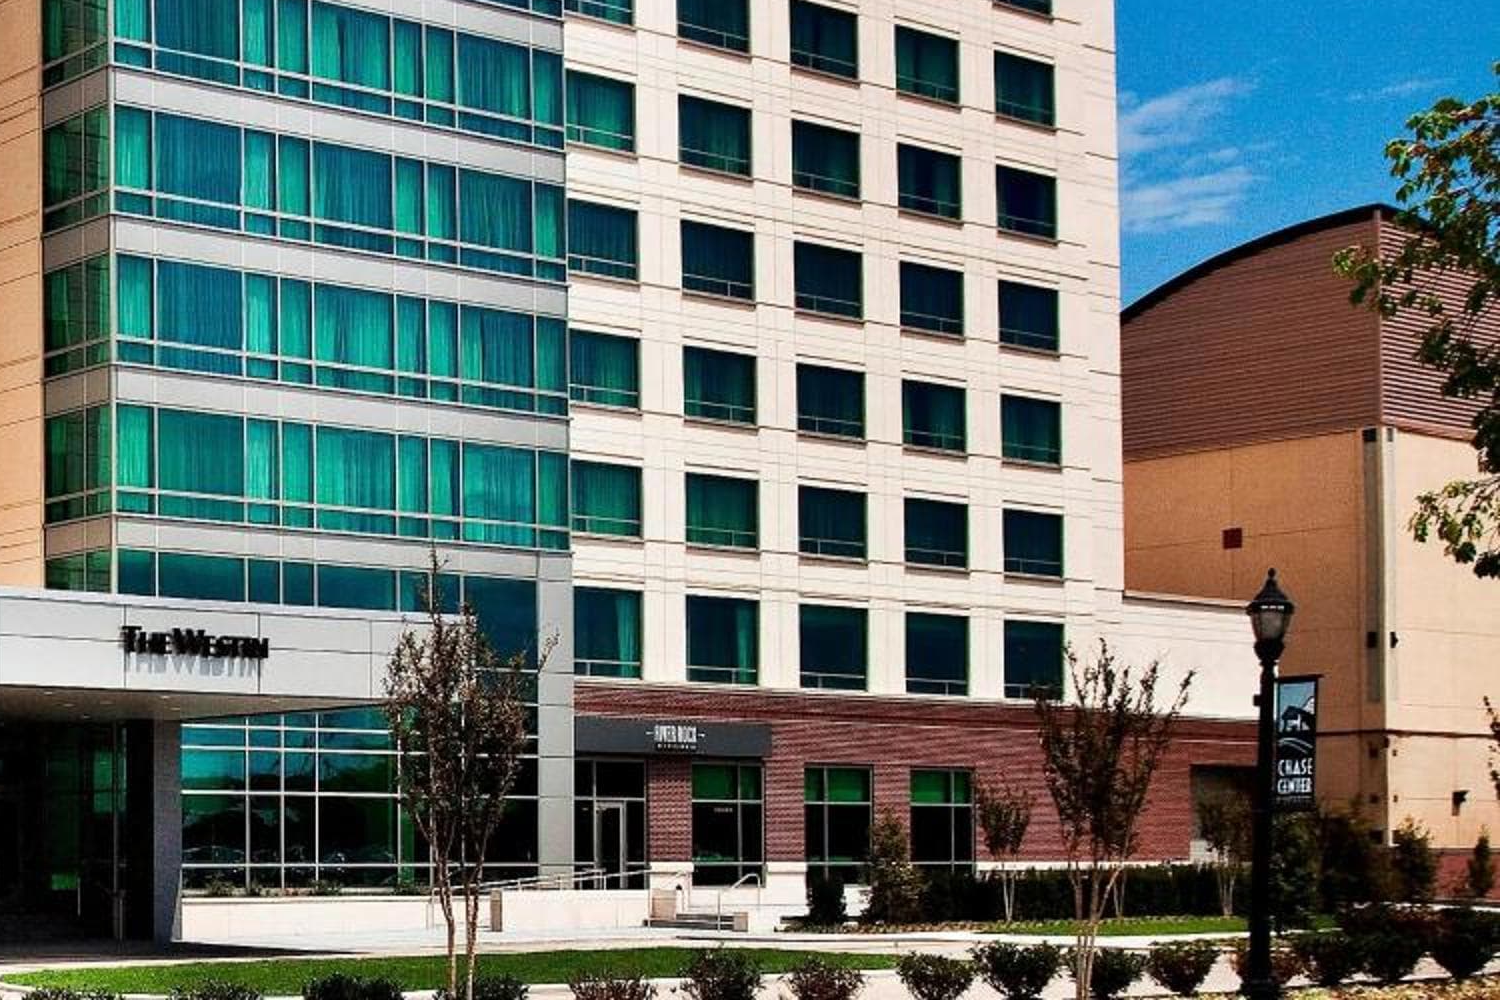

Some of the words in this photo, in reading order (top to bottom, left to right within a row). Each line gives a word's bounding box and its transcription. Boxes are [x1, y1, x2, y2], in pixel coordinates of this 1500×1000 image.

[121, 625, 172, 655] THE
[172, 627, 269, 659] WESTIN
[1278, 758, 1313, 776] CHASE
[1278, 778, 1312, 794] CENTER
